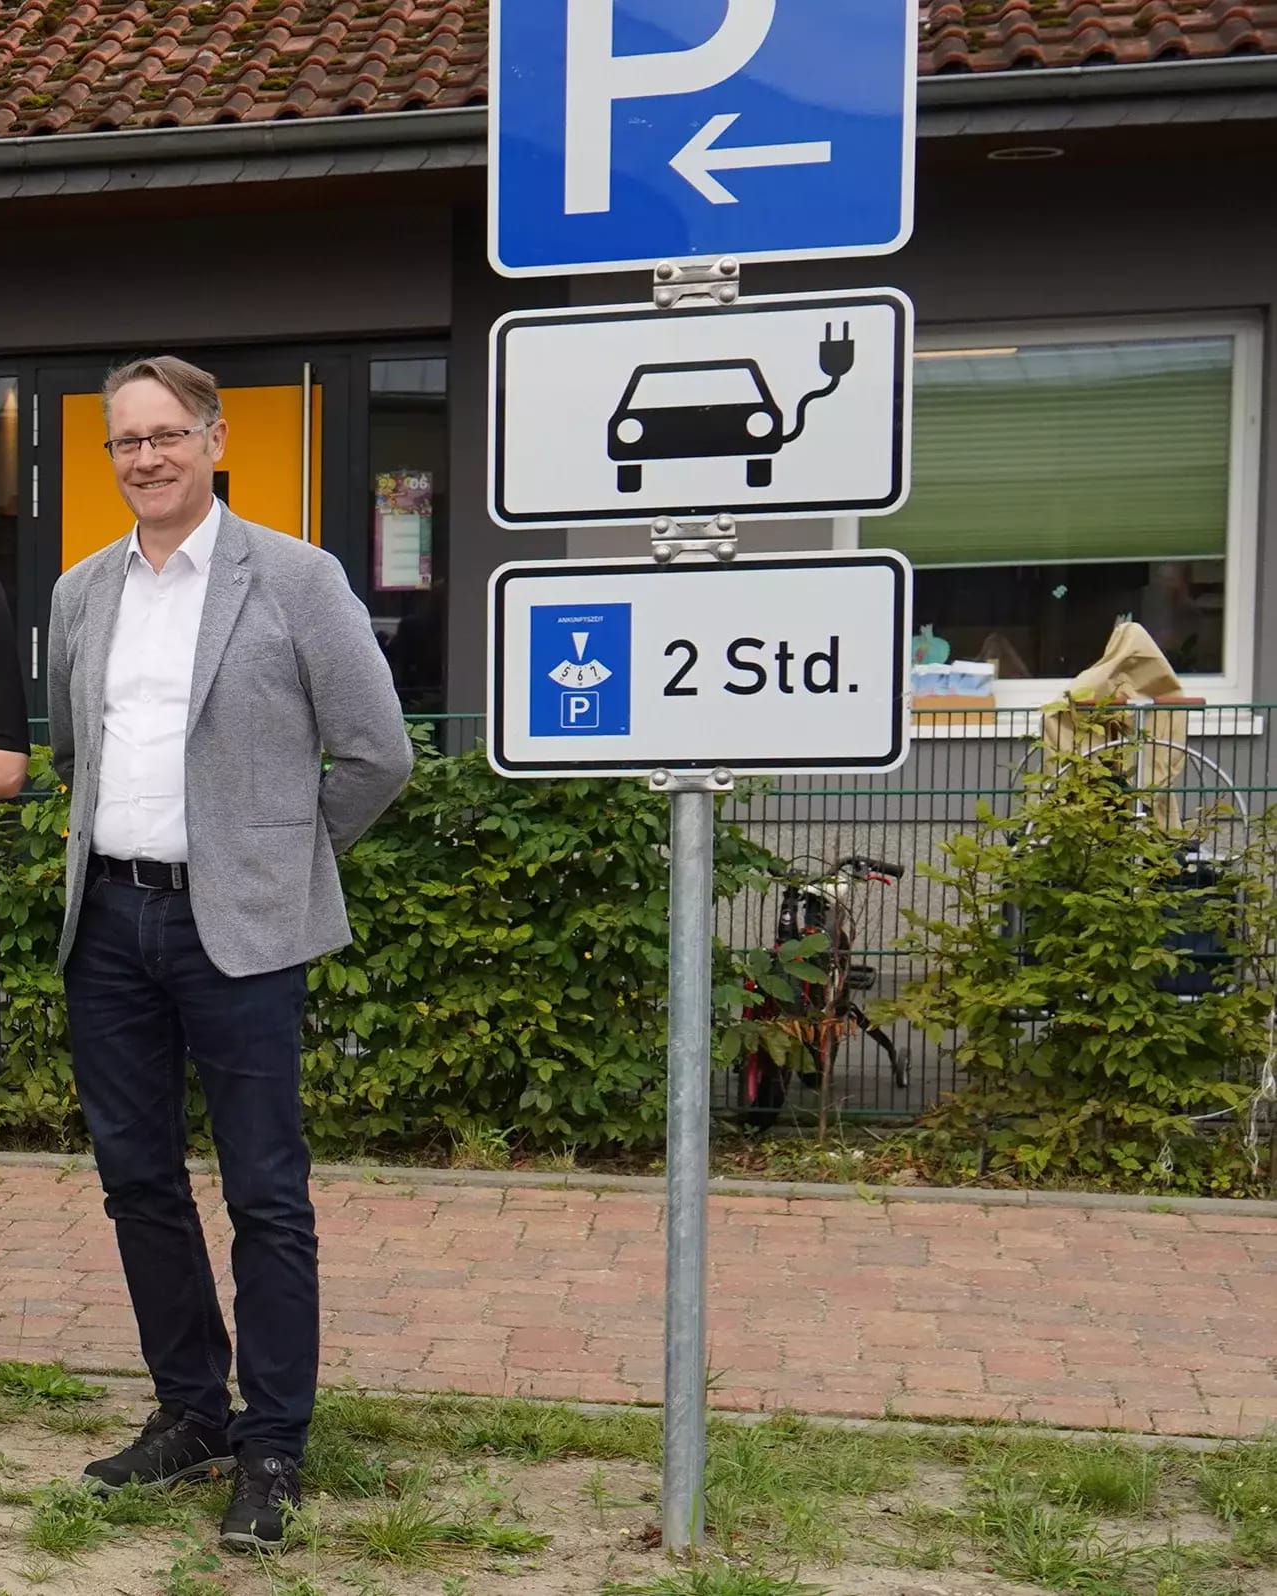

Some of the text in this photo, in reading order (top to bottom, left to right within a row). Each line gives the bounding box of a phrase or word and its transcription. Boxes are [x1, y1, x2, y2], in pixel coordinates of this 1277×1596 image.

[564, 0, 776, 215] P
[562, 666, 571, 677] 5
[577, 670, 583, 681] 6
[590, 666, 598, 677] 7
[663, 635, 859, 696] 2 Std.
[569, 696, 590, 723] P
